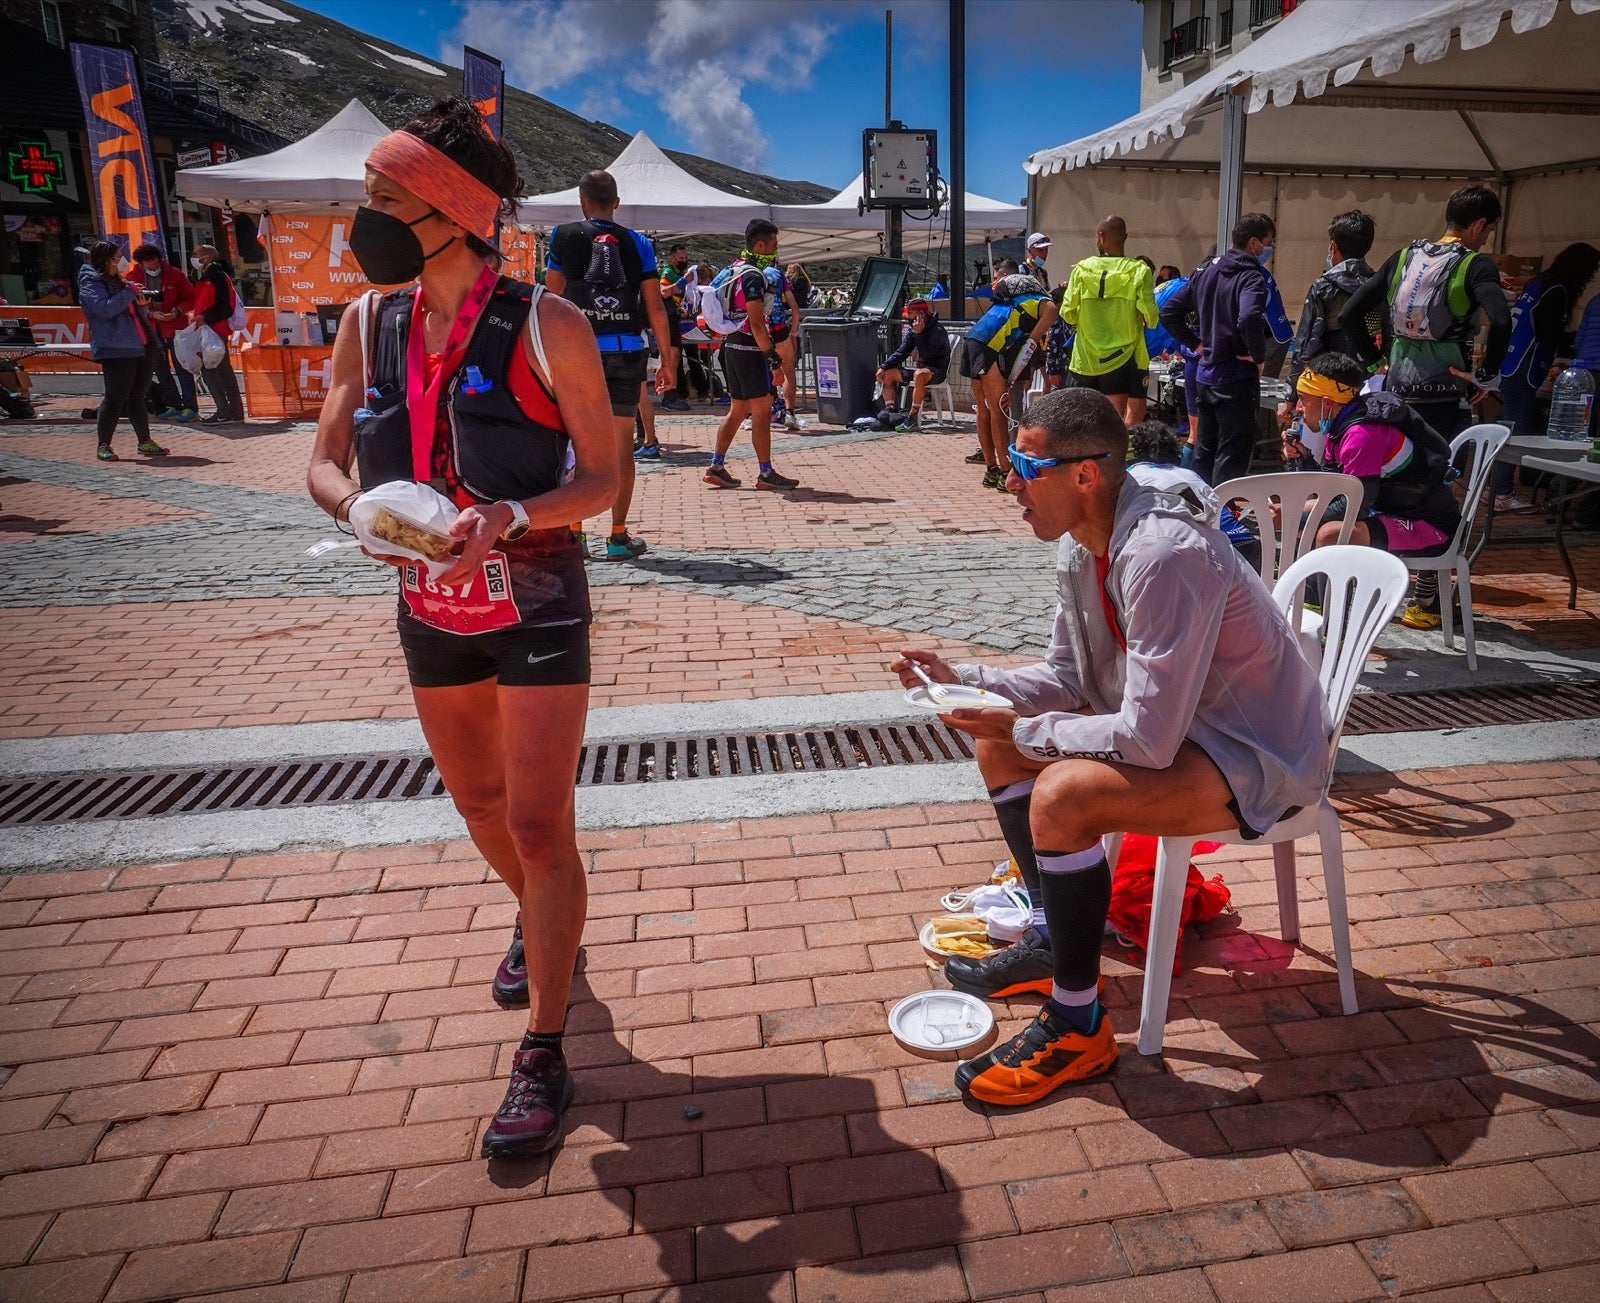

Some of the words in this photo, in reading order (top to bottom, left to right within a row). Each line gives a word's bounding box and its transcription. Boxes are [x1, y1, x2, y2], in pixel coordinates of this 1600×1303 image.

[286, 221, 309, 229] HSN
[271, 235, 294, 243] HSN
[289, 251, 312, 260] HSN
[274, 265, 297, 273] HSN
[292, 281, 315, 289] HSN
[278, 295, 300, 303] HSN
[310, 296, 333, 304] HSN
[1032, 746, 1124, 761] saomon
